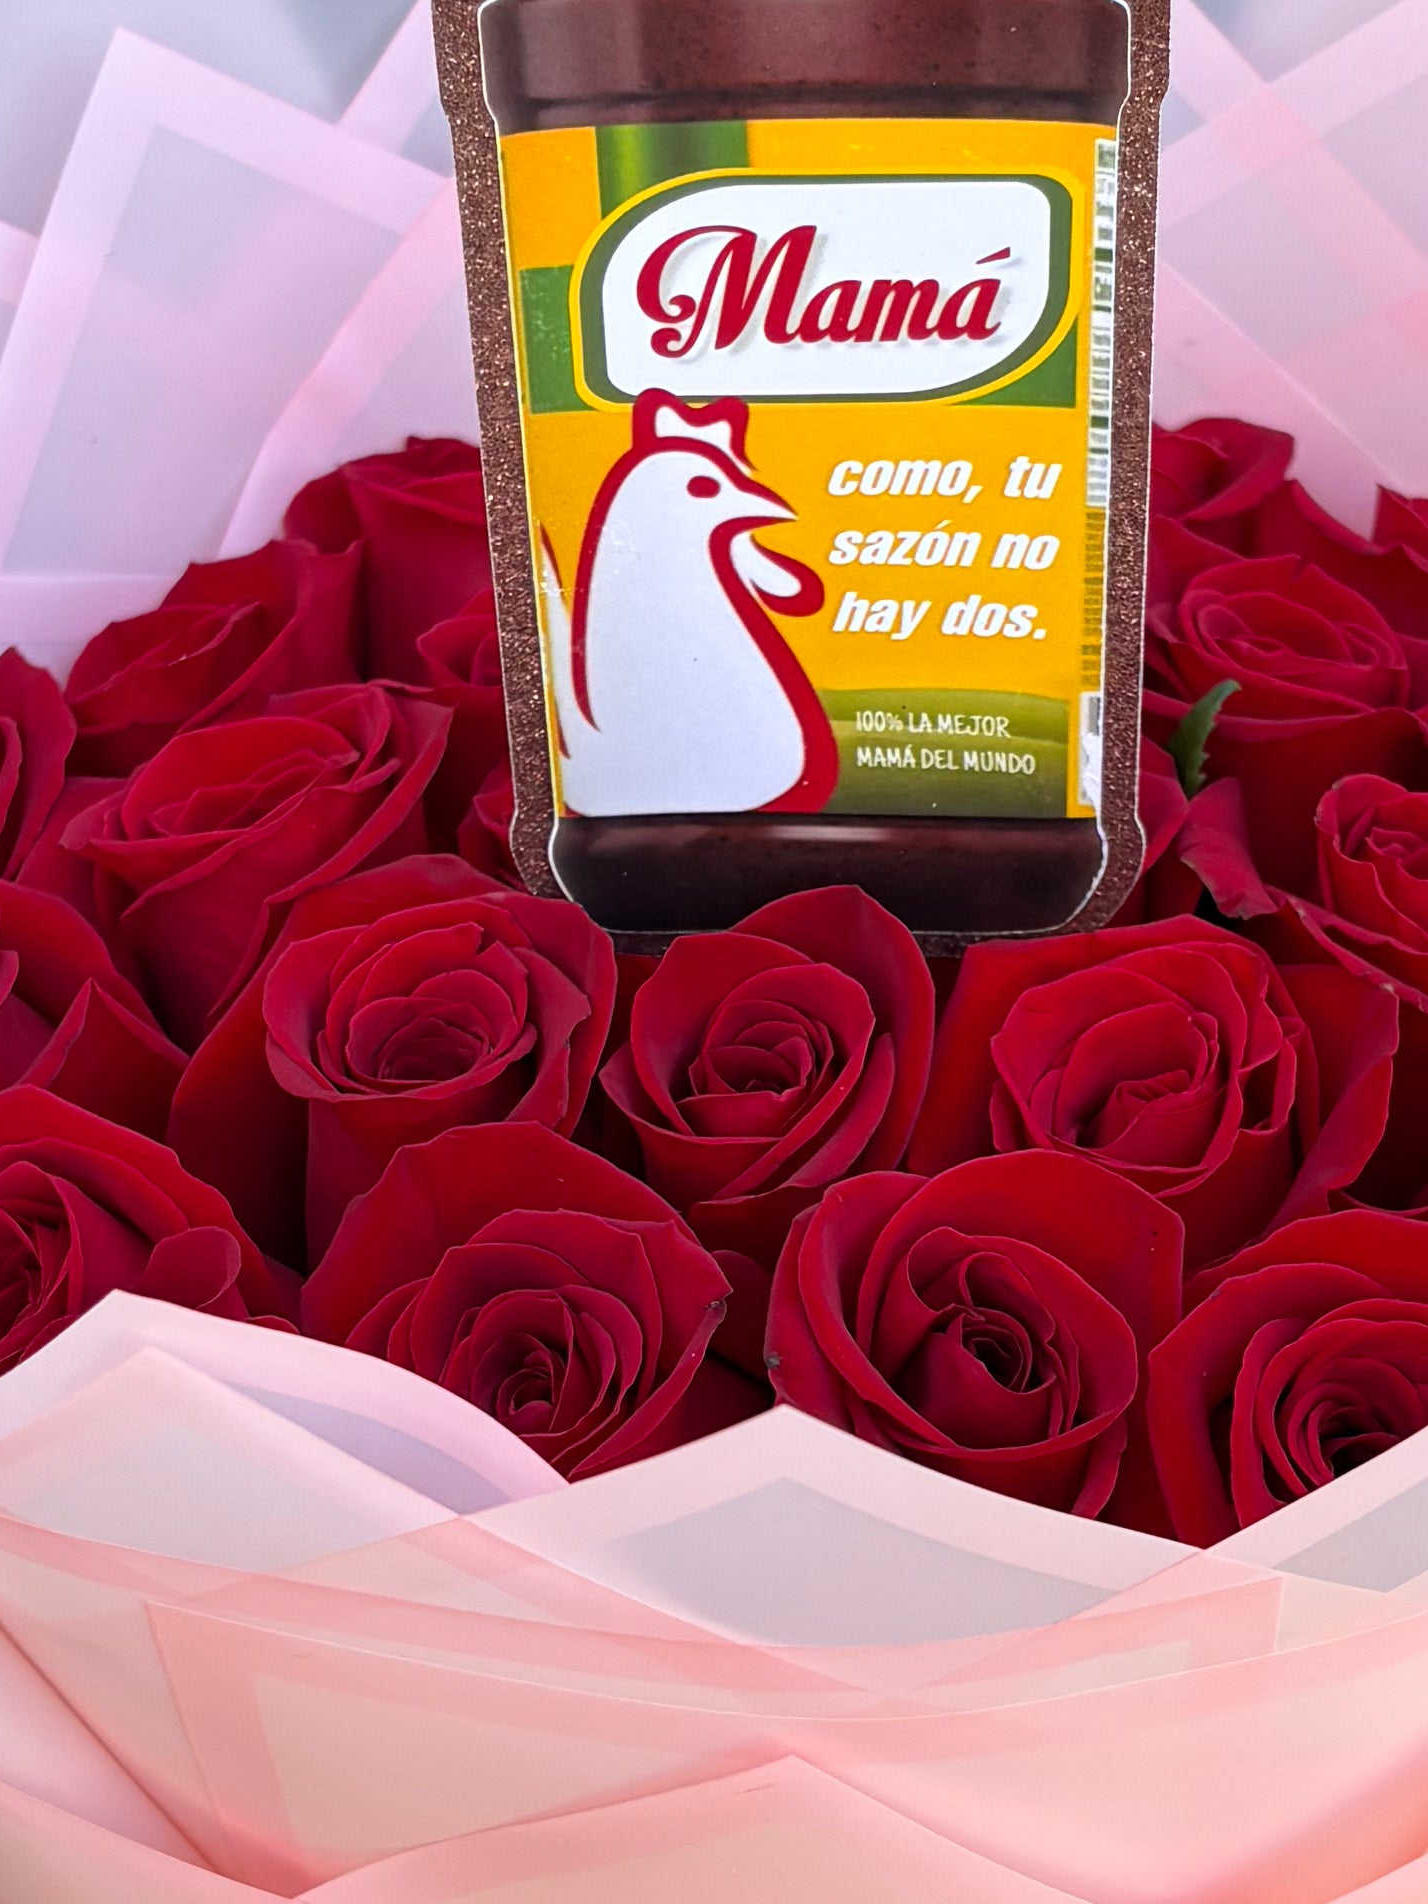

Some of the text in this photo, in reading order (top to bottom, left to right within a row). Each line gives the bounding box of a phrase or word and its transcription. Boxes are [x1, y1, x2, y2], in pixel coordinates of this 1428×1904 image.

[636, 225, 1011, 358] Mamá
[828, 456, 1063, 504] como, tu
[828, 519, 1060, 570] sazón no
[832, 591, 1047, 640] hay dos.
[856, 710, 1011, 738] 100% LA MEJOR
[856, 744, 1036, 775] MAMÁ DEL MUNDO
